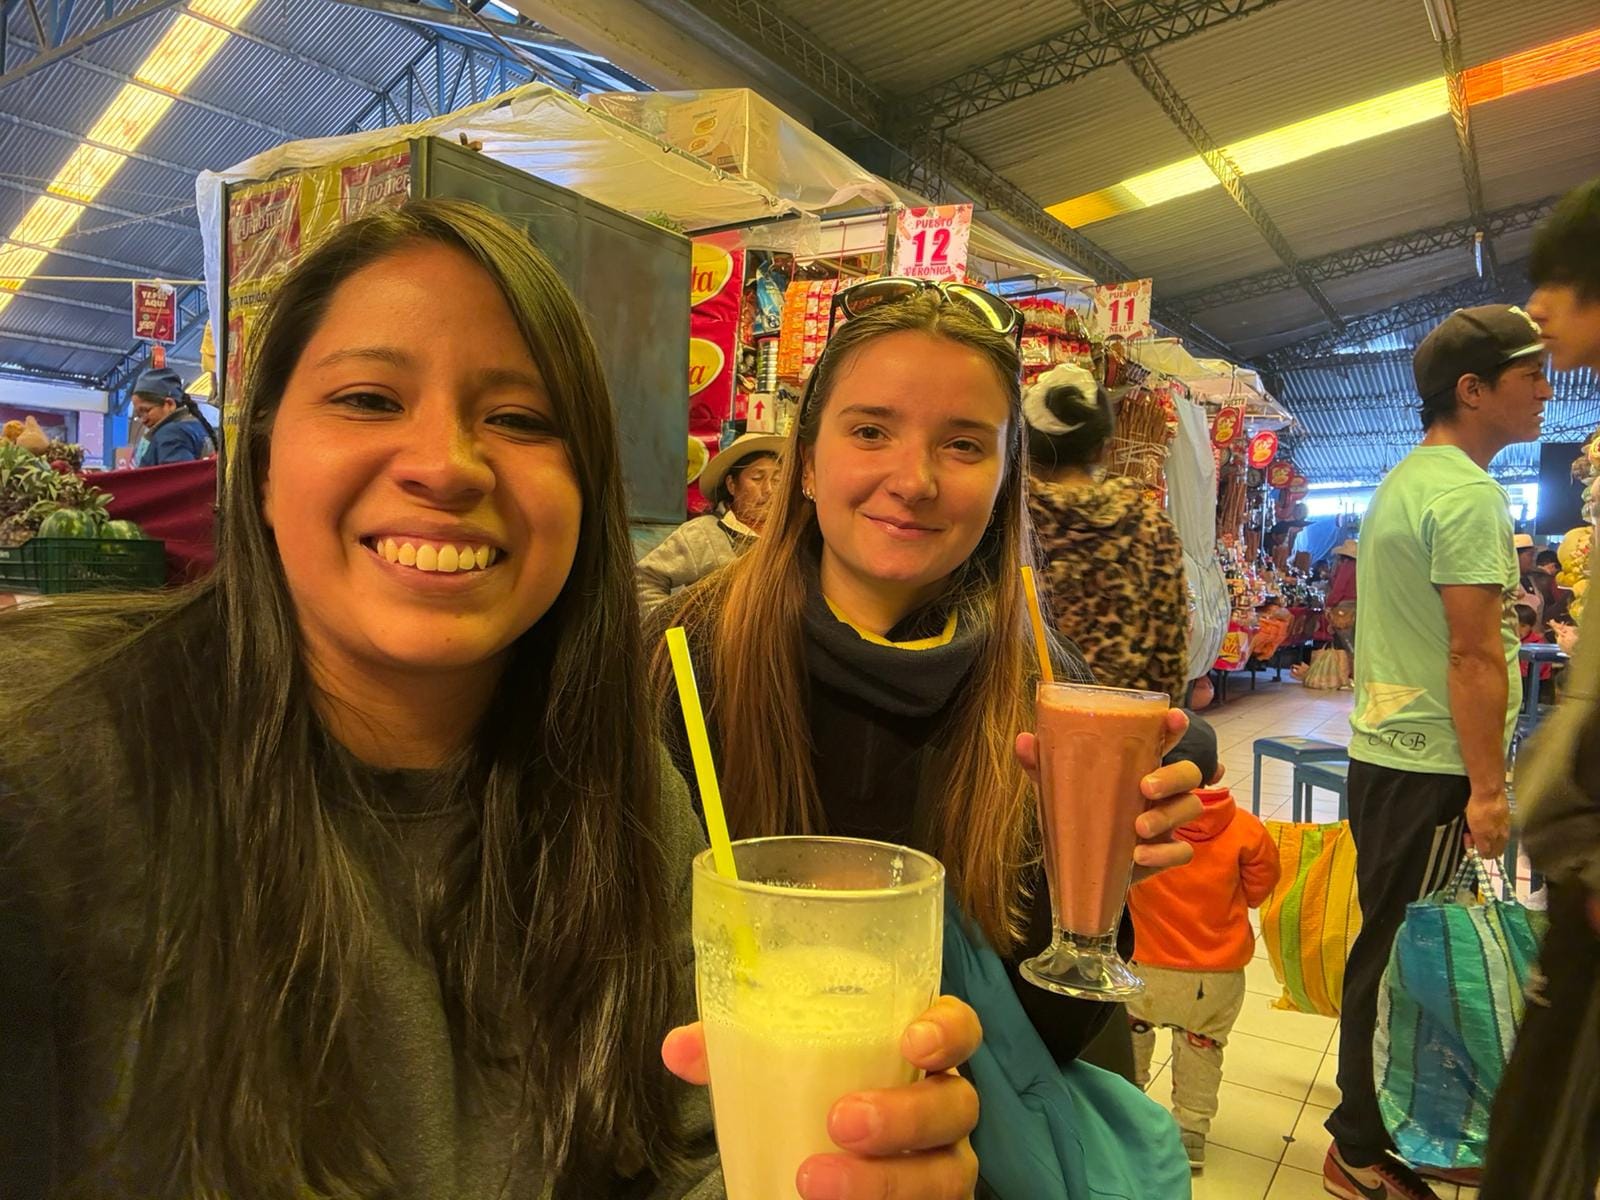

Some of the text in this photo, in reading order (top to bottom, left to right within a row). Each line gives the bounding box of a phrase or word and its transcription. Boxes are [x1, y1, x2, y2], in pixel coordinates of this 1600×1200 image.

[915, 217, 953, 229] PUESTO
[912, 228, 951, 267] 12
[1109, 298, 1135, 326] 11
